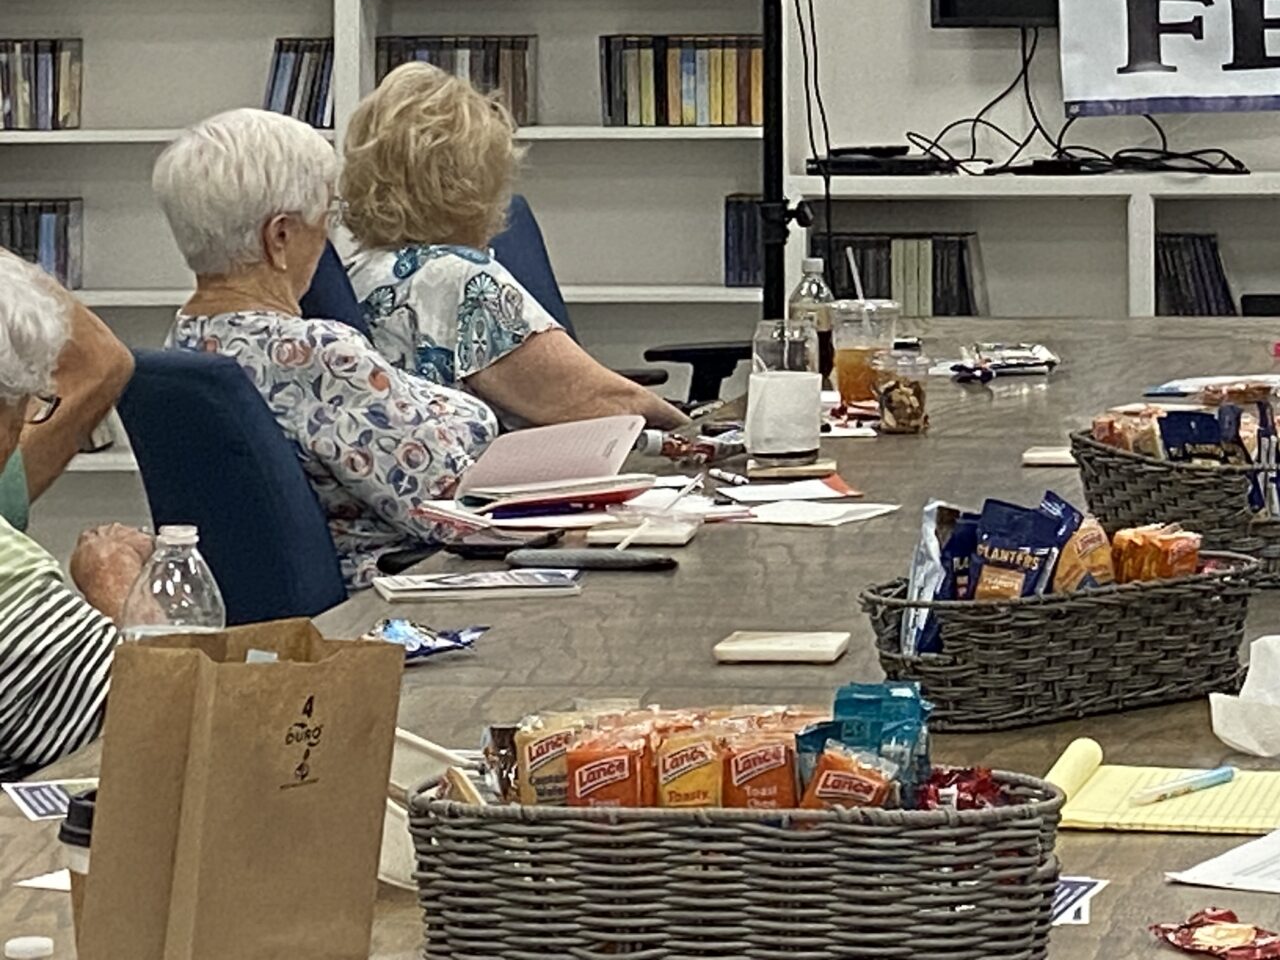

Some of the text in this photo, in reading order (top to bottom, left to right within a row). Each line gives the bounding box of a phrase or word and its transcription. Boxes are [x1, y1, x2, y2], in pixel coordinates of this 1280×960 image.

[976, 543, 1040, 571] PLANTERS
[734, 746, 784, 773] Lance
[579, 760, 626, 787] Lance
[821, 773, 876, 797] Lance
